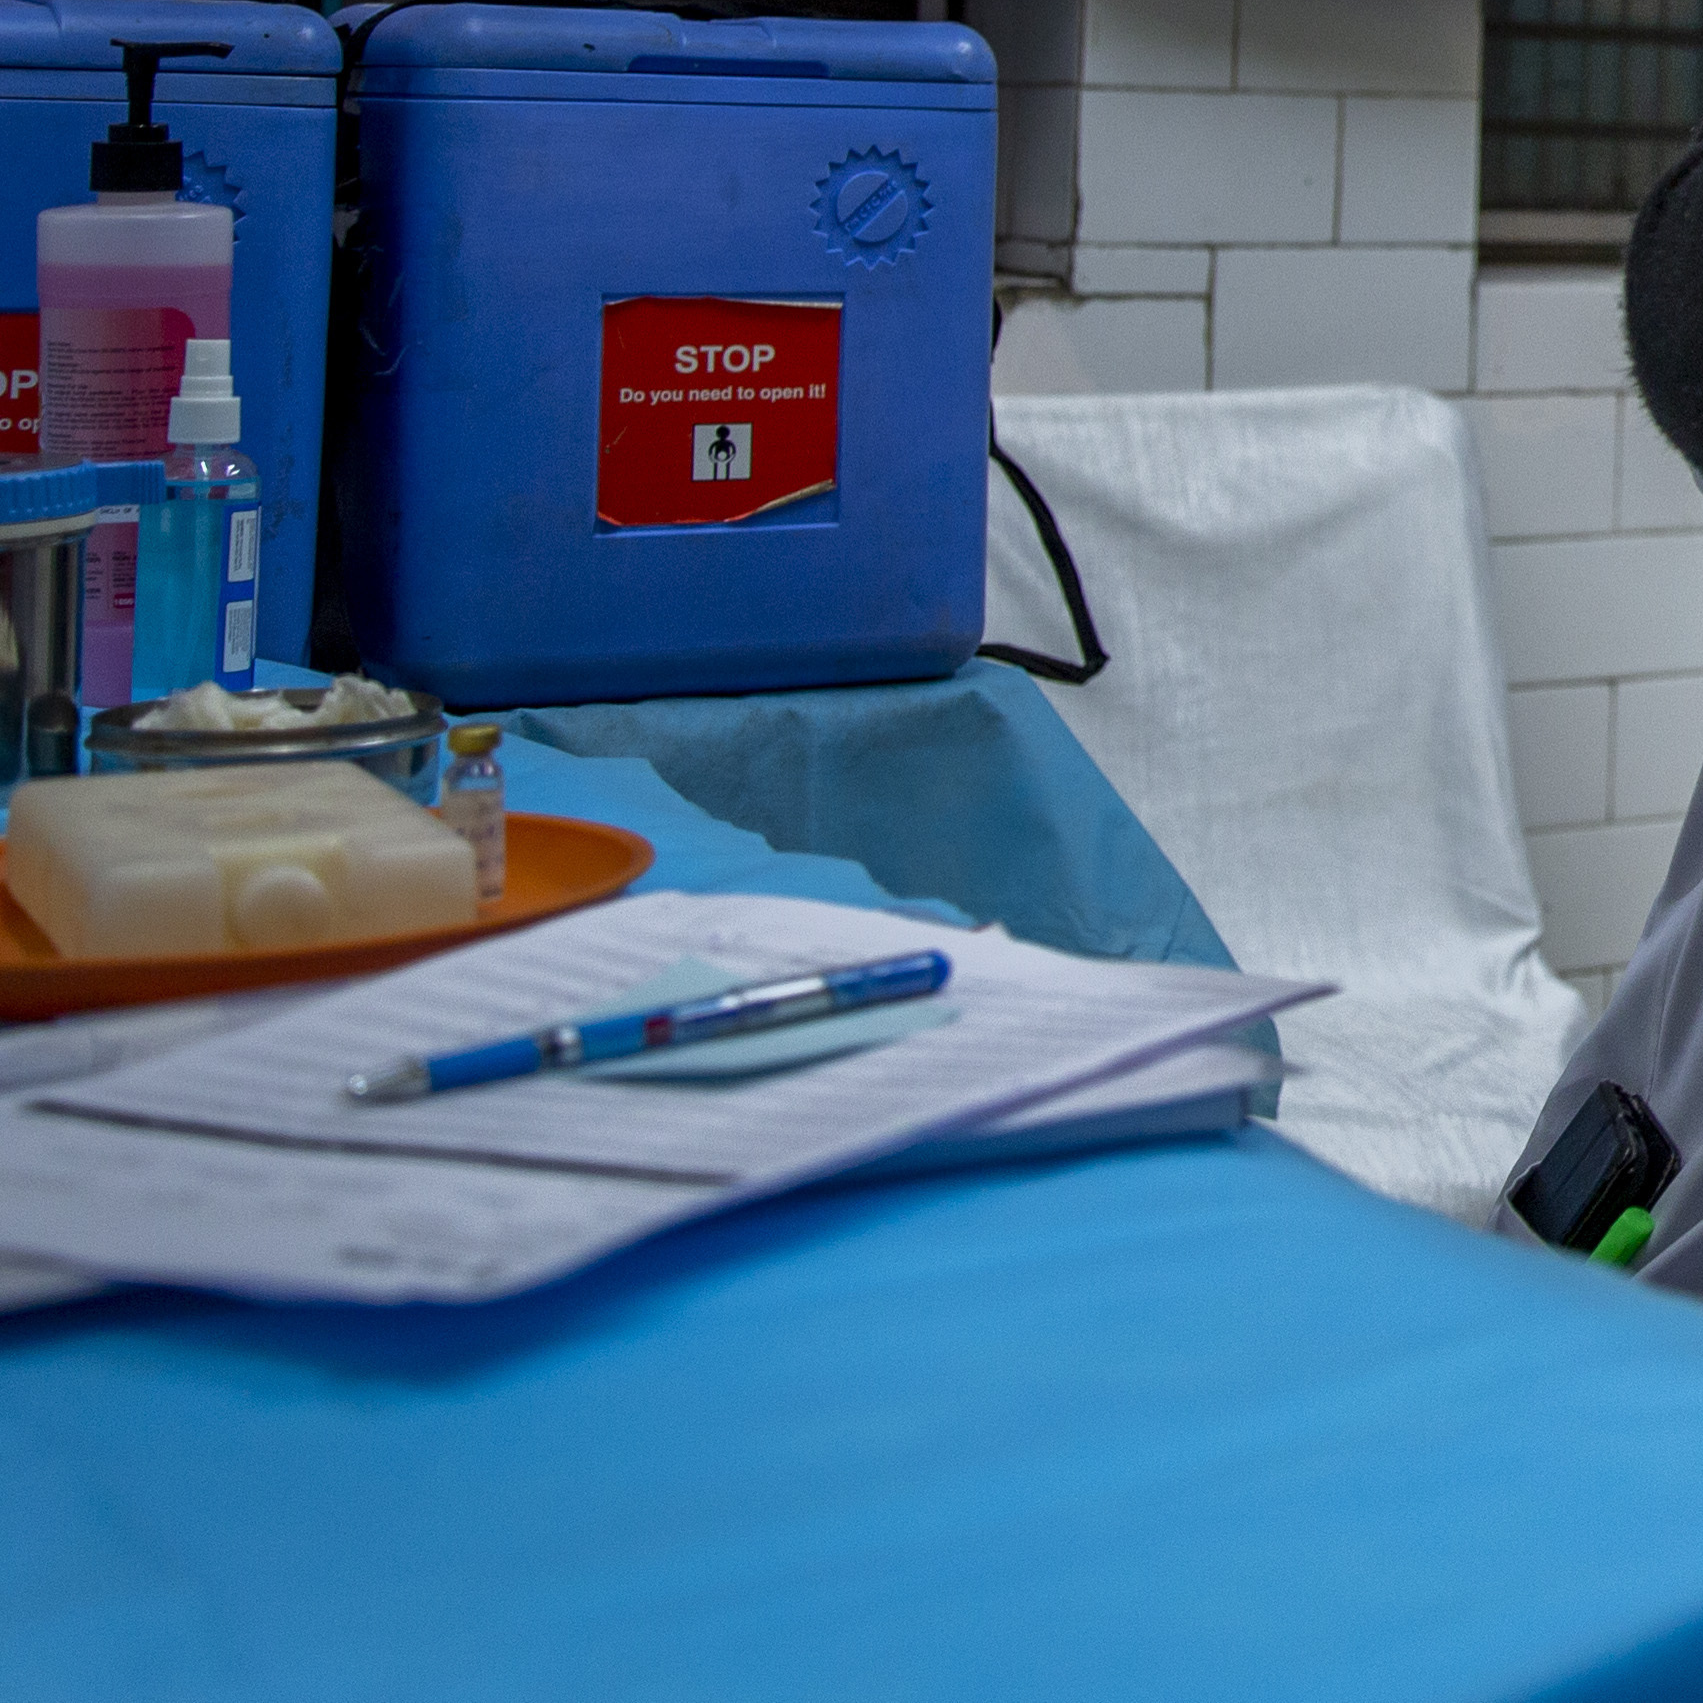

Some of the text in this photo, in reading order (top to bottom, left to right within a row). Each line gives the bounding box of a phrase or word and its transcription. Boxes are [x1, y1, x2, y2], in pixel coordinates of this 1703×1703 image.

[674, 344, 775, 373] STOP
[619, 387, 645, 404] Do
[650, 388, 683, 406] you
[688, 384, 733, 402] need
[738, 385, 754, 401] to
[759, 385, 805, 405] open
